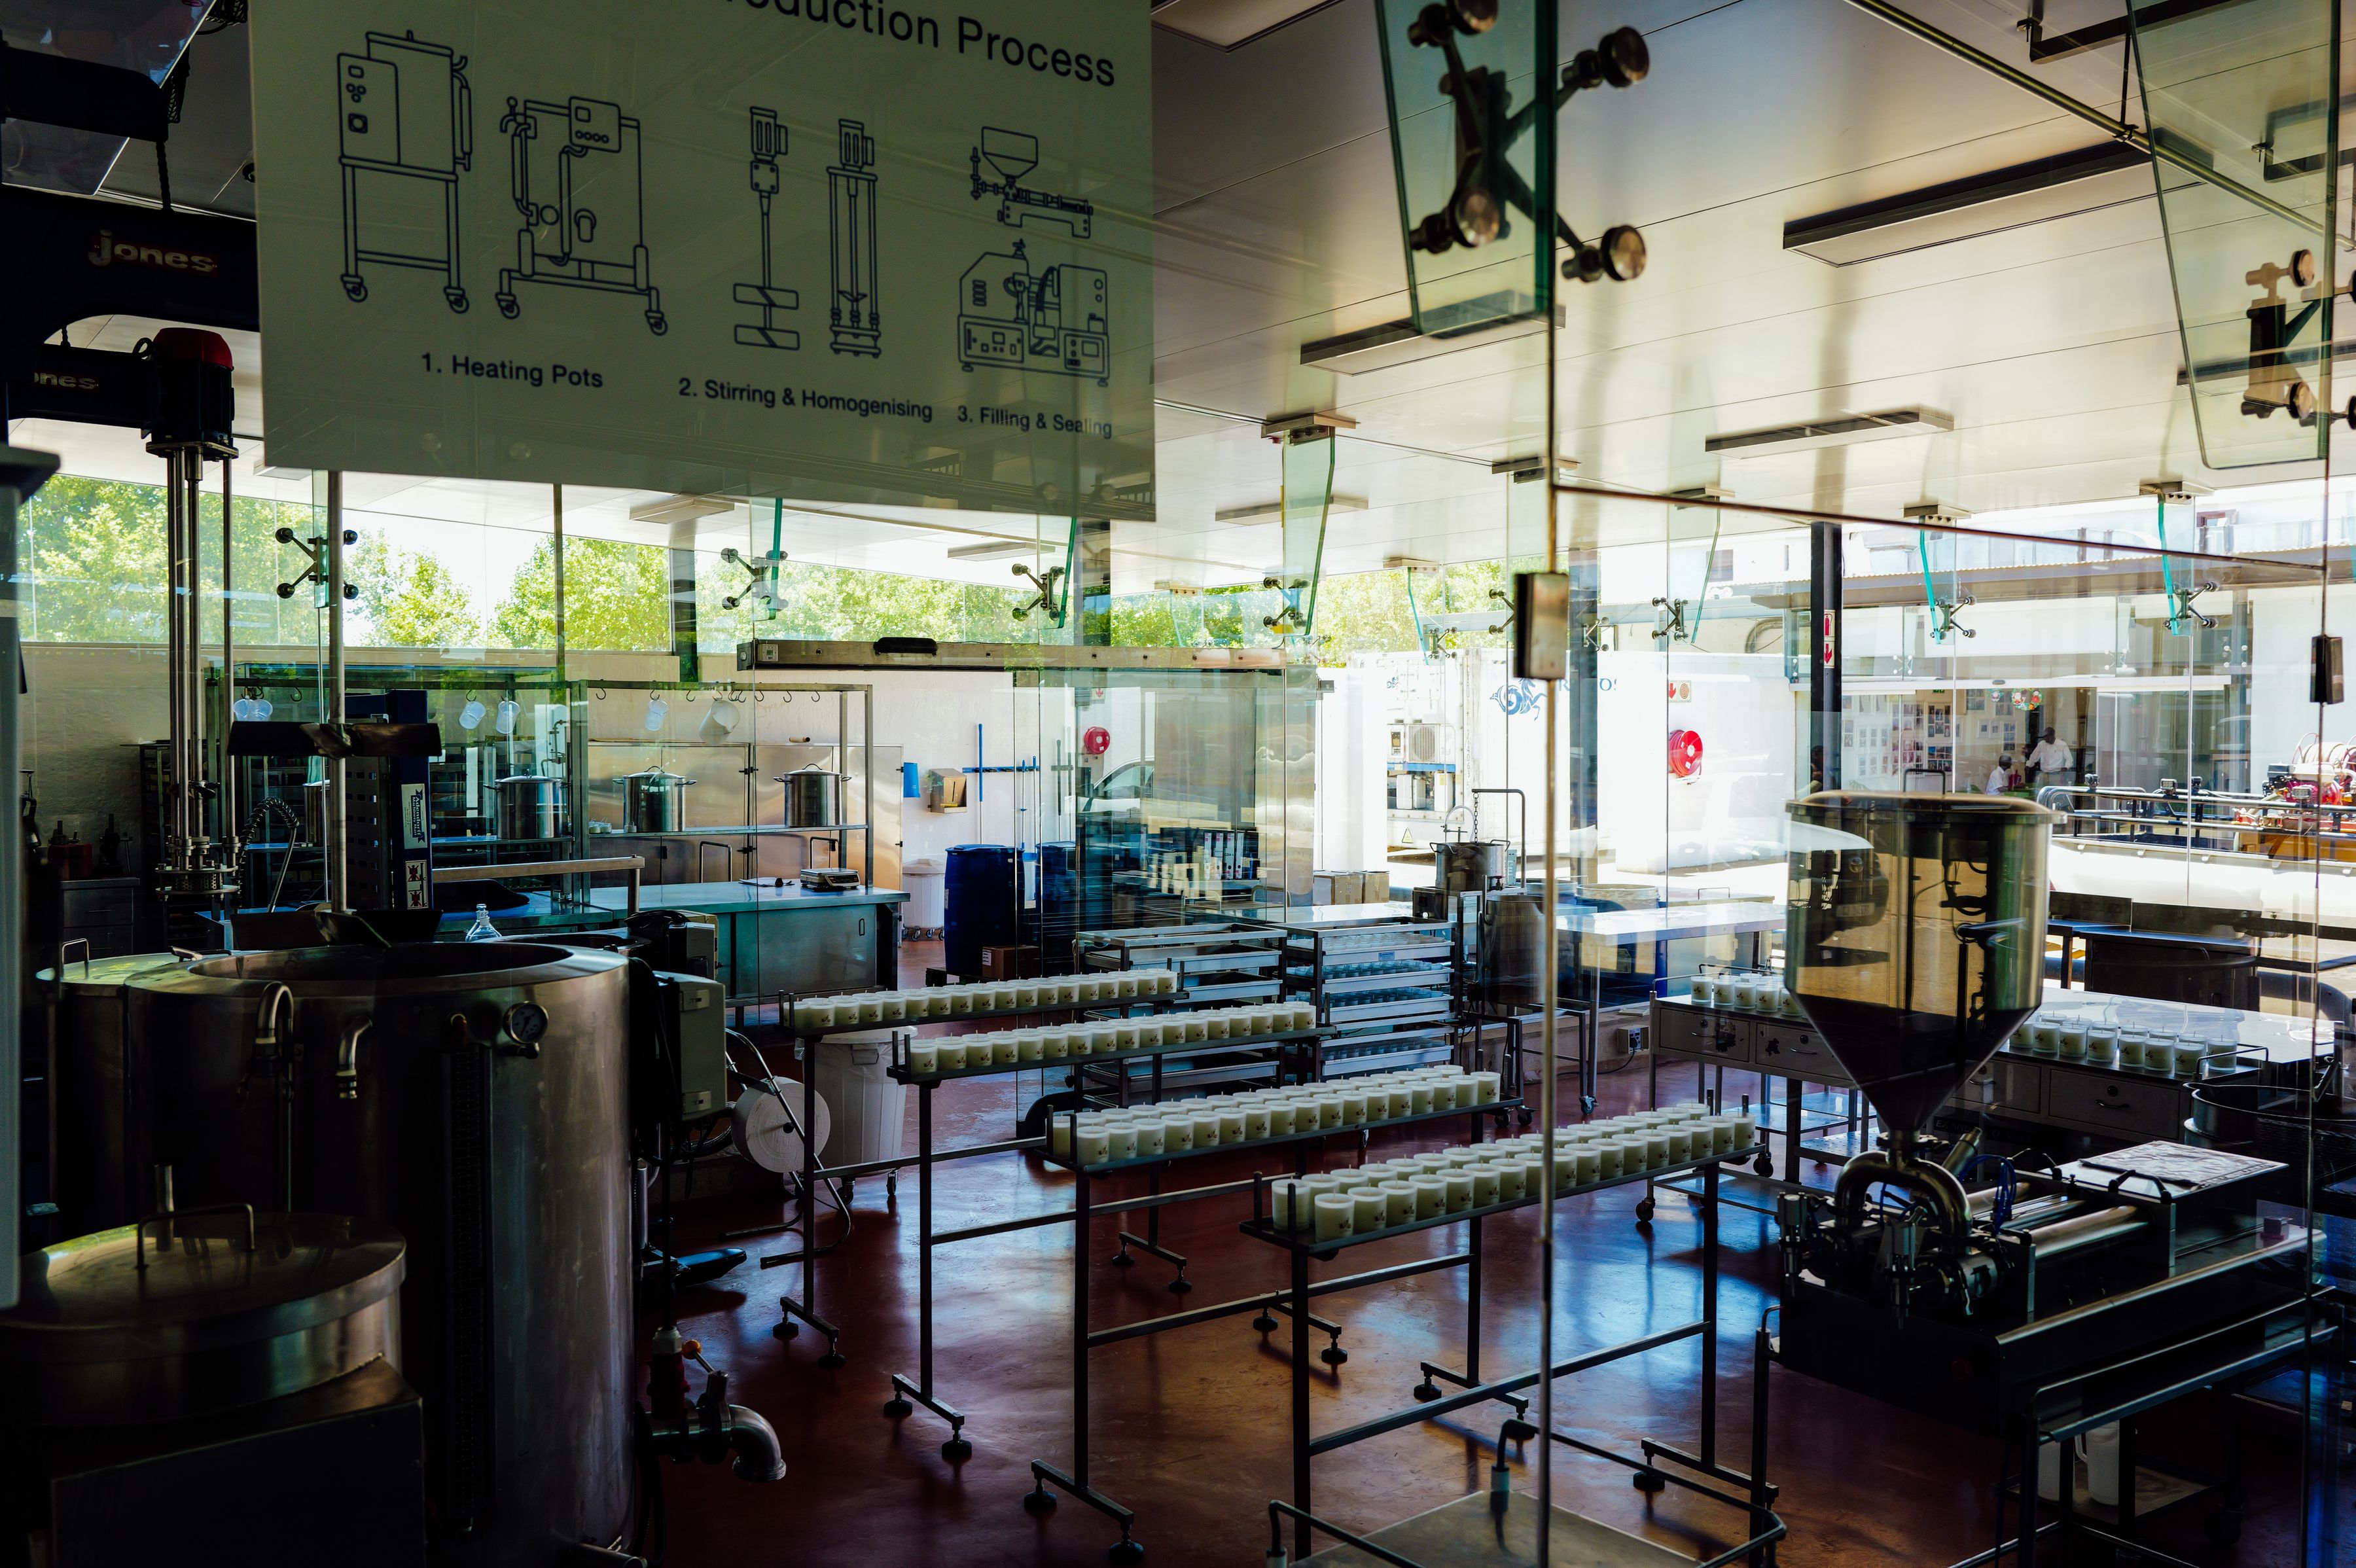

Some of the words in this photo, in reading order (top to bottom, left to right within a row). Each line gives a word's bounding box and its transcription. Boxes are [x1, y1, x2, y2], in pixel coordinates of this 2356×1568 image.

[726, 0, 939, 48] uction
[957, 16, 1115, 87] Process
[87, 229, 215, 273] jones
[33, 372, 96, 389] nes
[421, 352, 442, 374] 1.
[452, 355, 543, 387] Heating
[552, 364, 603, 388] Pots
[678, 377, 697, 397] 2.
[704, 379, 776, 408] Stirring
[781, 387, 796, 406] &
[802, 389, 933, 423] Homogenising
[957, 404, 973, 423] 3.
[980, 407, 1030, 432] Filling
[1035, 412, 1047, 429] &
[1053, 414, 1112, 440] Sealing
